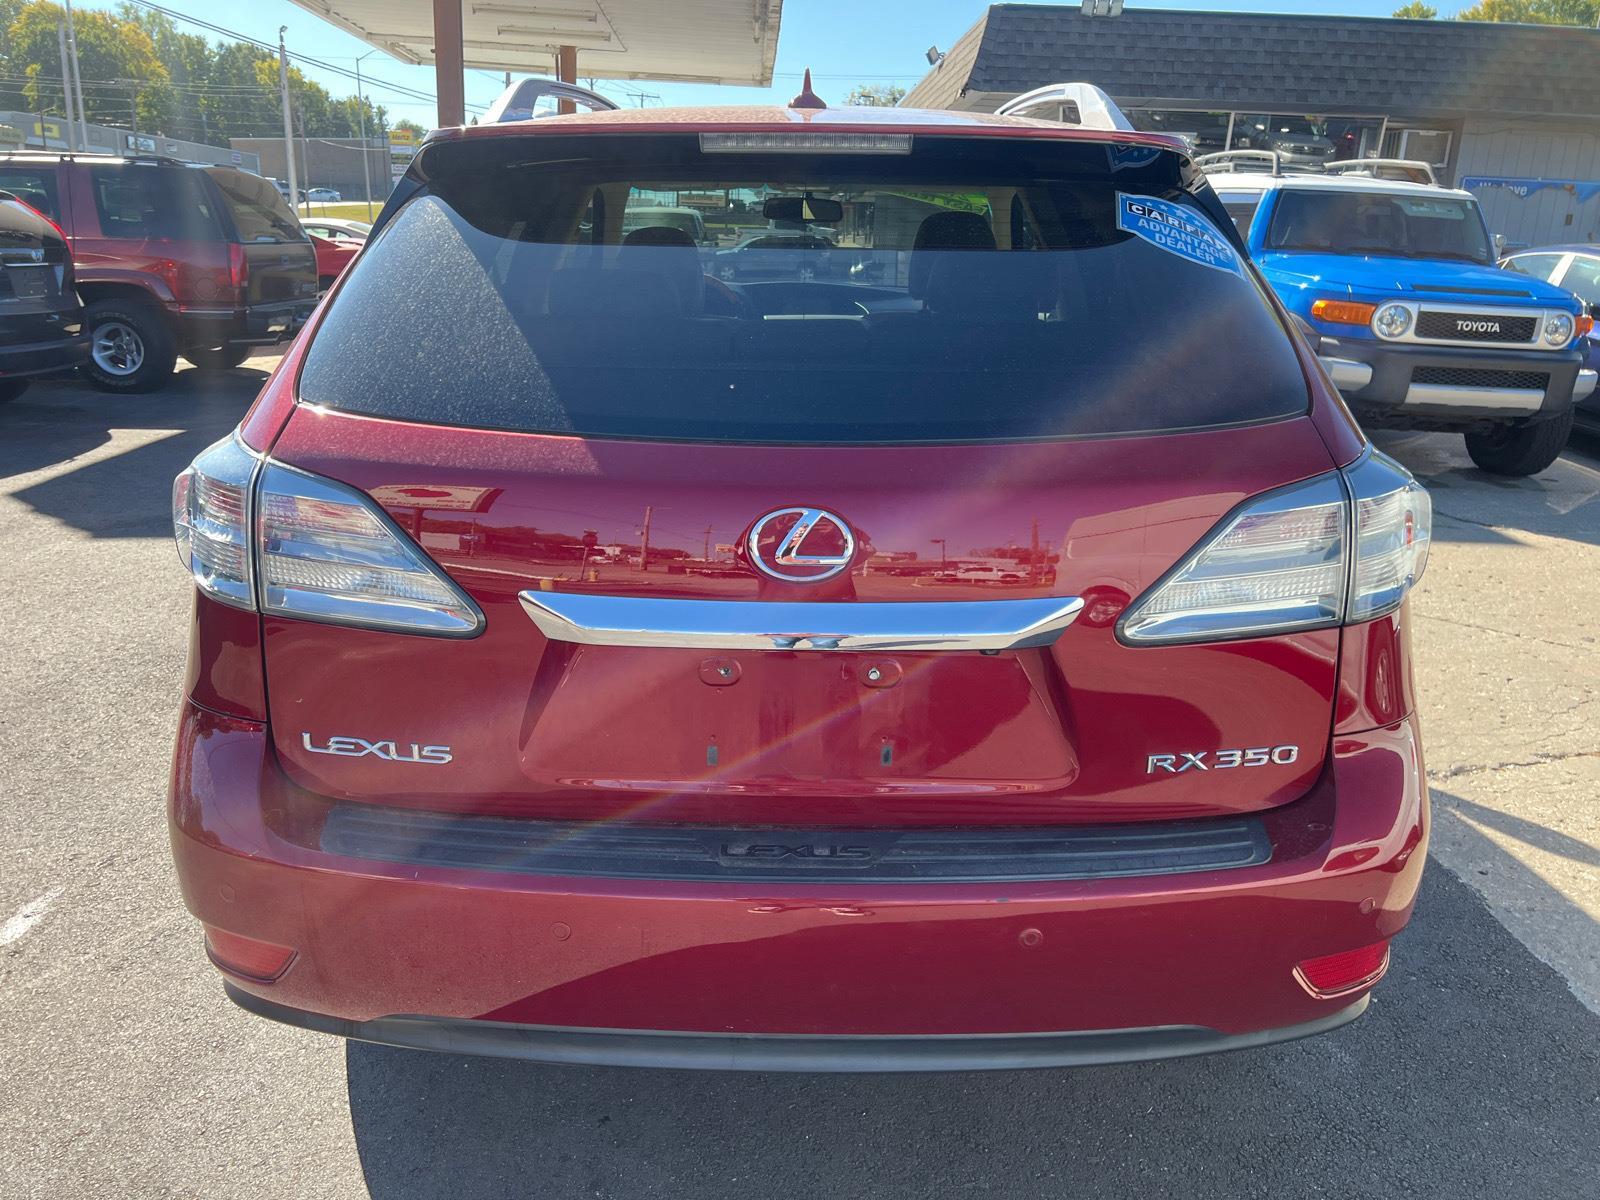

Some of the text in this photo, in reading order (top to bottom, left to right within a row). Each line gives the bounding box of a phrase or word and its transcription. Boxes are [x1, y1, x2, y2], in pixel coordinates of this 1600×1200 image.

[1137, 218, 1231, 263] ADVANTAGE
[1155, 233, 1216, 265] DEALER
[1456, 320, 1500, 333] TOYOTA
[302, 732, 453, 764] LEXUS
[1146, 745, 1299, 774] RX 350
[720, 844, 873, 861] LEXUS
